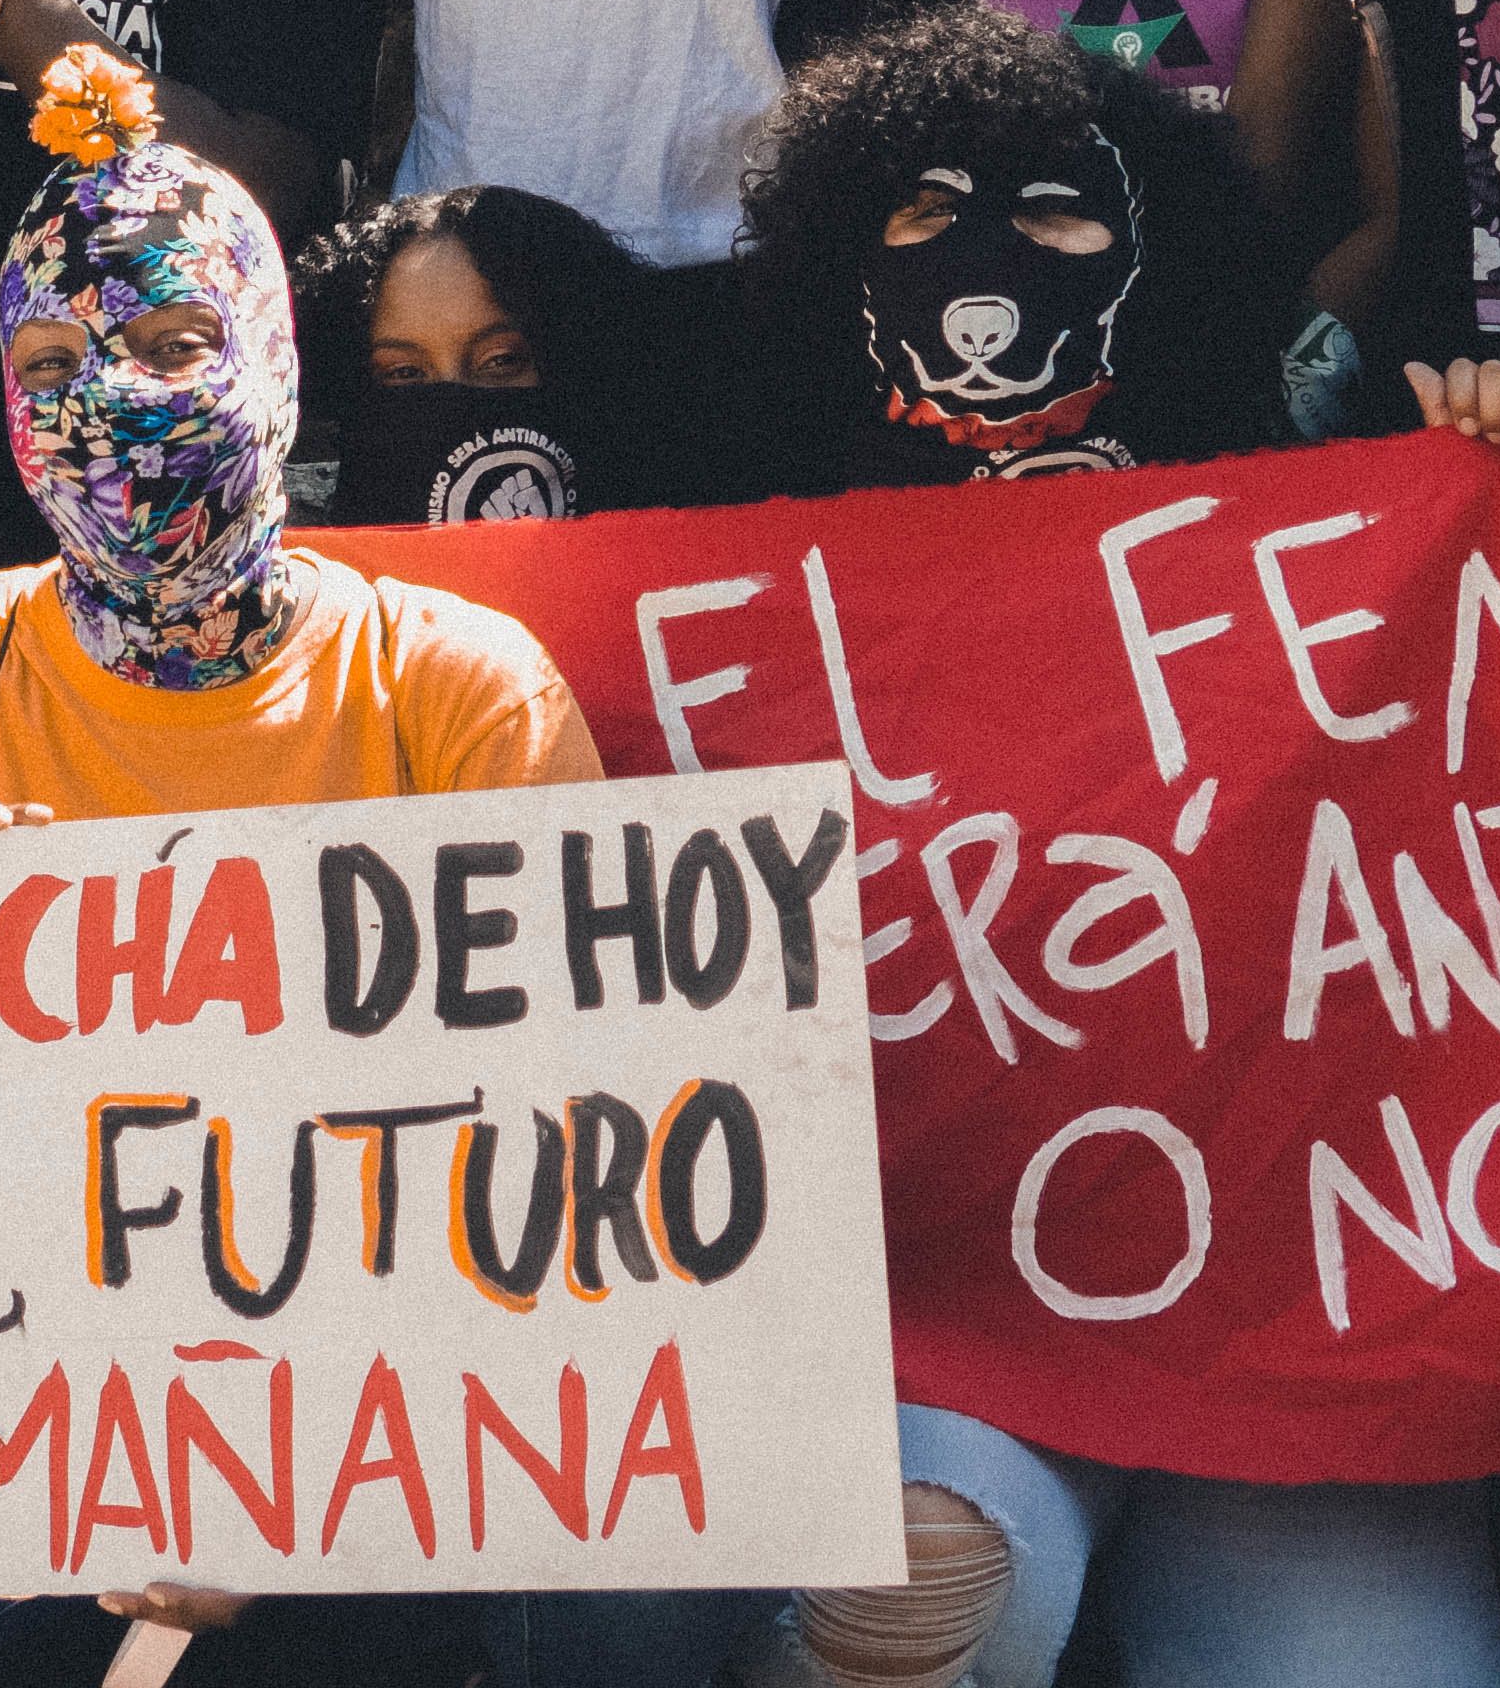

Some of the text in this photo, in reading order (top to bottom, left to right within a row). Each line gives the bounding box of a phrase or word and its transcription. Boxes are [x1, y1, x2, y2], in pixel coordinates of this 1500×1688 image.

[447, 432, 489, 468] SERÁ
[635, 545, 949, 810] EL
[317, 840, 530, 1037] DE
[561, 808, 850, 1013] HOY
[83, 1075, 768, 1320] FUTURO
[1010, 1104, 1213, 1320] O
